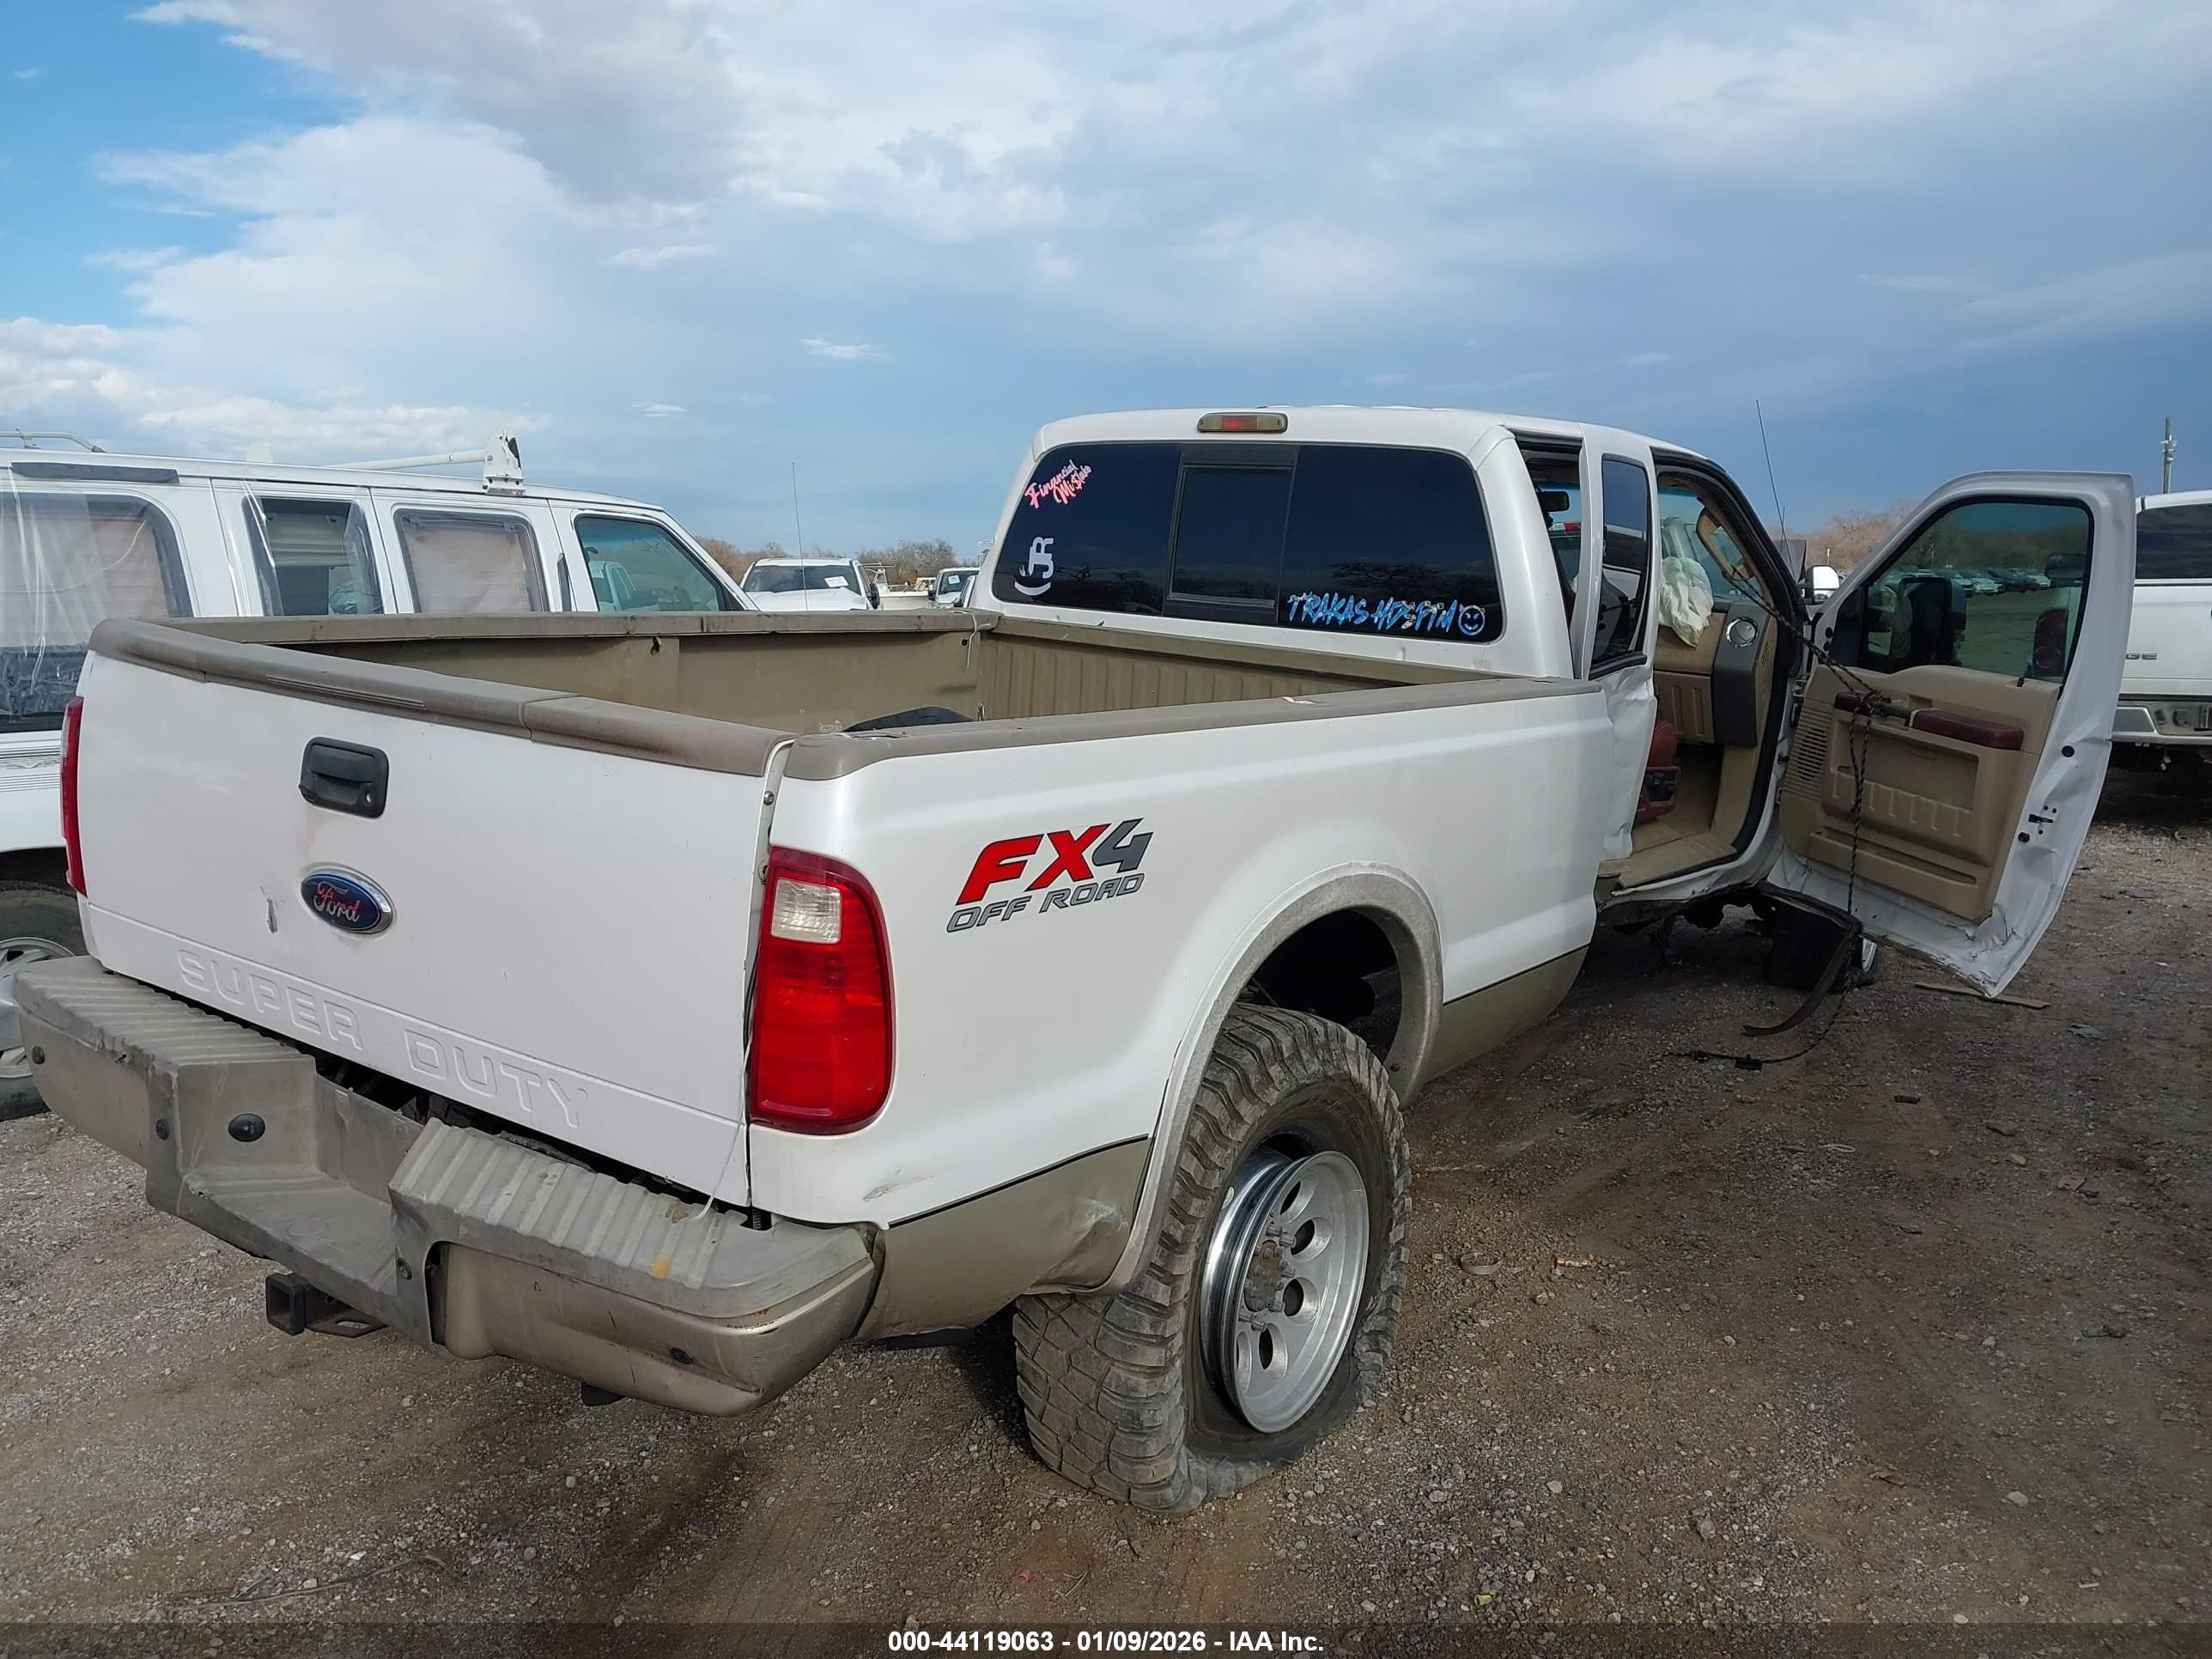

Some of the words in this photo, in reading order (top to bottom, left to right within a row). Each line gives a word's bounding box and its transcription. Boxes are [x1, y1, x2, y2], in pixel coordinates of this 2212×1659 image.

[955, 817, 1154, 906] FX4
[313, 880, 361, 922] Ford
[946, 895, 1032, 933] OFF
[1039, 872, 1146, 913] ROAD
[178, 949, 364, 1051] SUPER
[404, 1029, 589, 1129] DUTY
